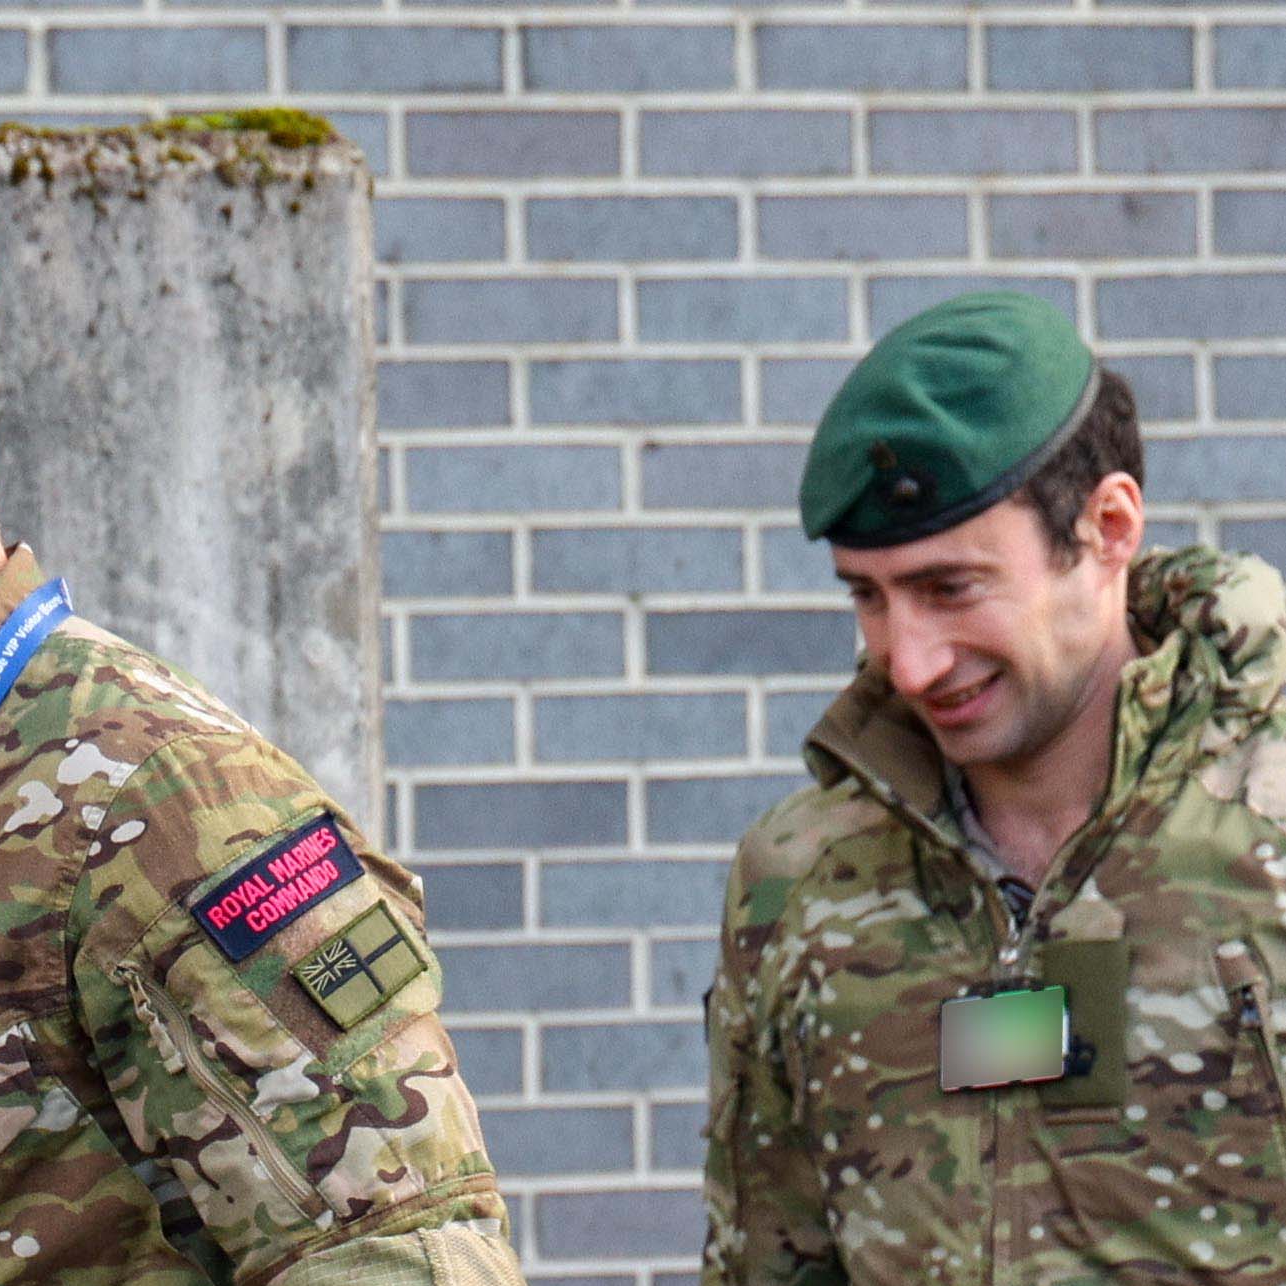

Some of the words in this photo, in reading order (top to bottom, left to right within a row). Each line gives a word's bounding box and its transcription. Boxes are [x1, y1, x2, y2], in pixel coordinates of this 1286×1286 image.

[2, 637, 20, 657] VIP
[15, 612, 43, 639] Visitor
[207, 874, 275, 930] ROYAL
[267, 827, 337, 883] MARINES
[246, 859, 339, 932] COMMANDO
